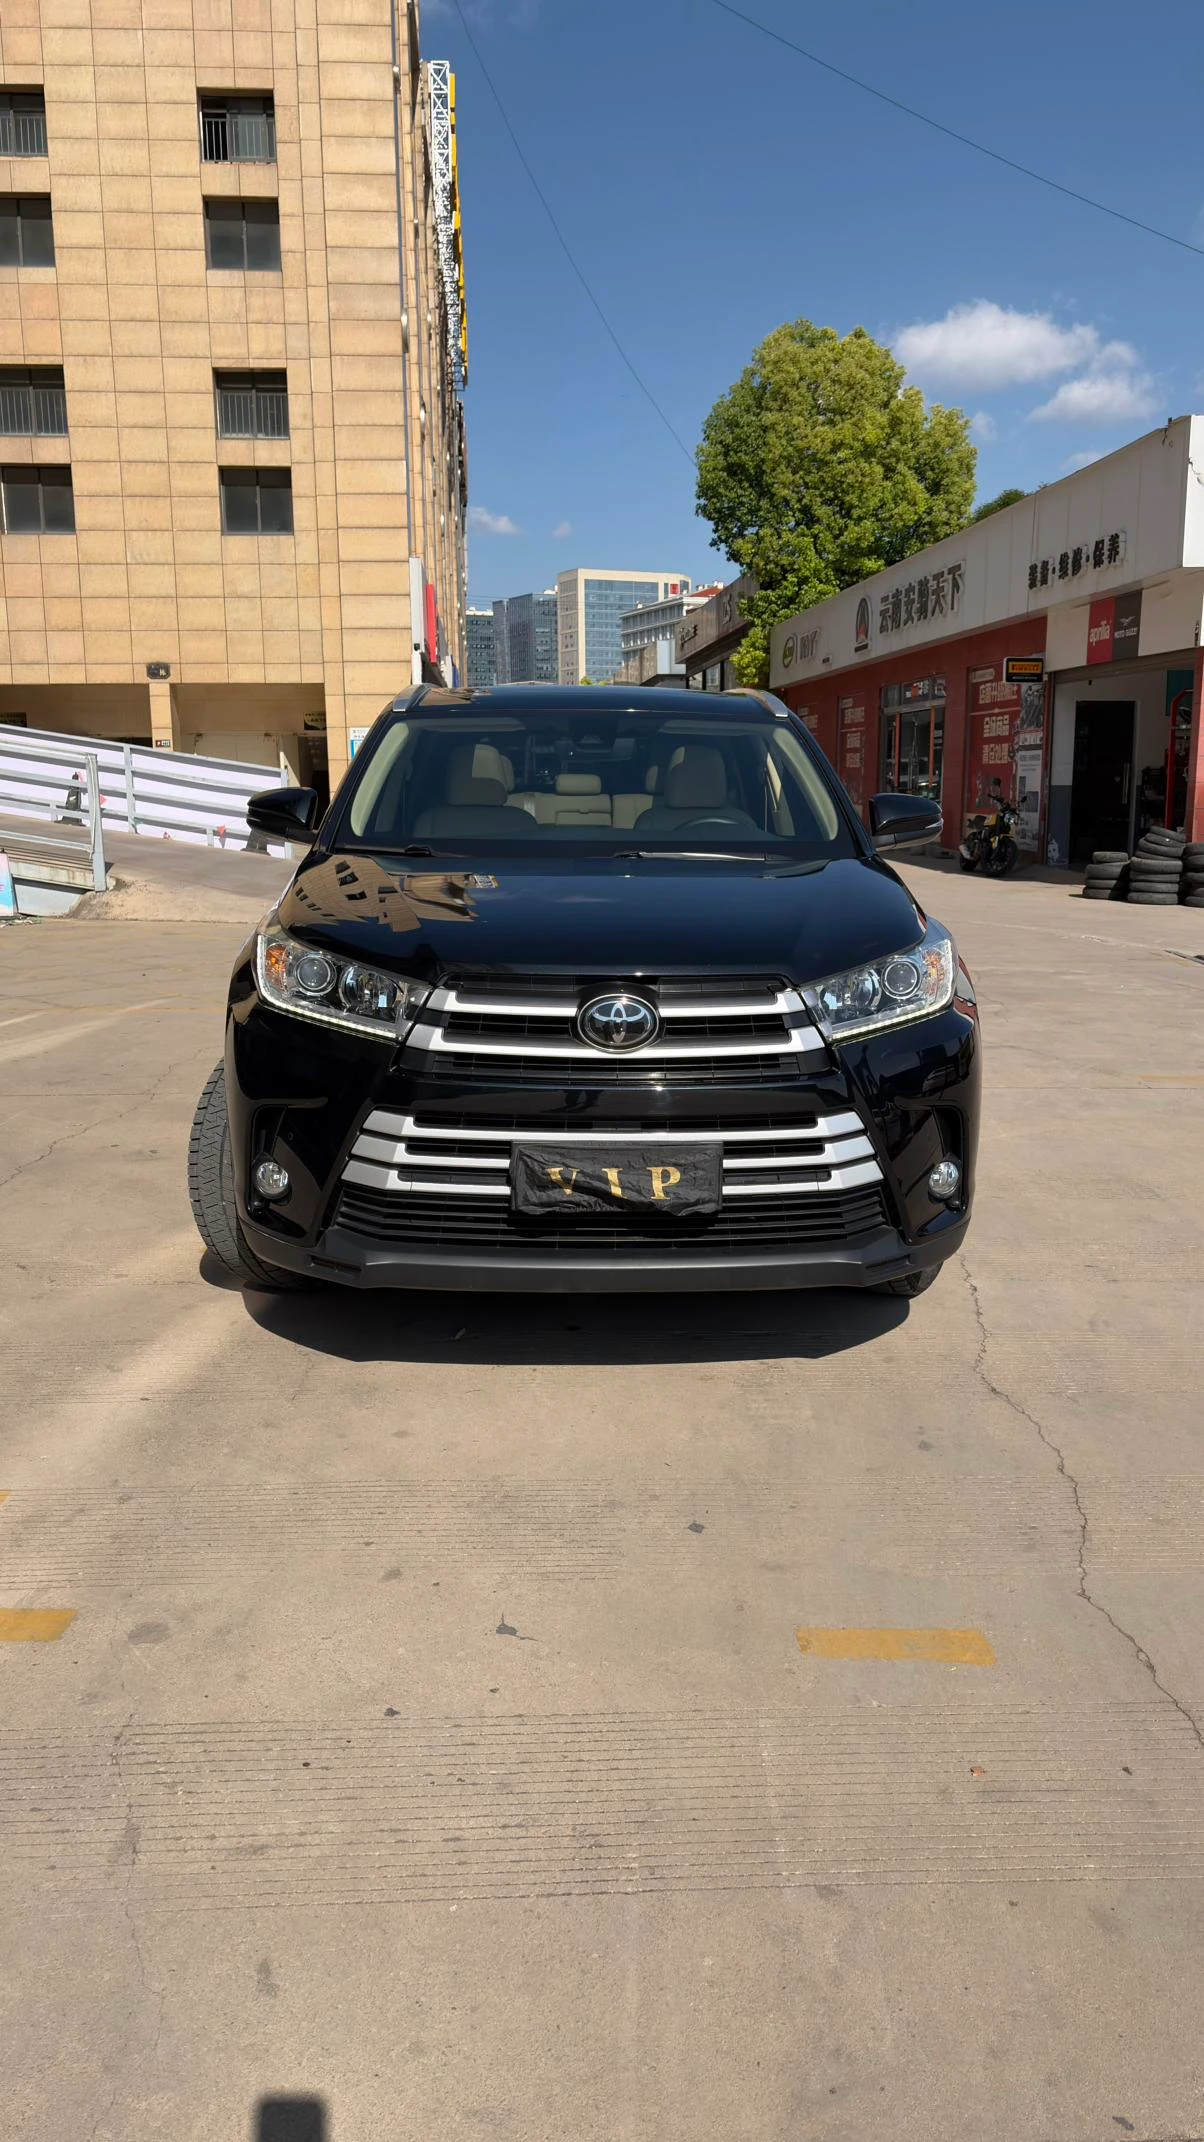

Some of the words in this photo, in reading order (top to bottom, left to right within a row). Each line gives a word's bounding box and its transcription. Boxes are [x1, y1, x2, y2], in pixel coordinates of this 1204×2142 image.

[879, 563, 963, 634] 云南安骑天下
[546, 1166, 681, 1200] VIP
